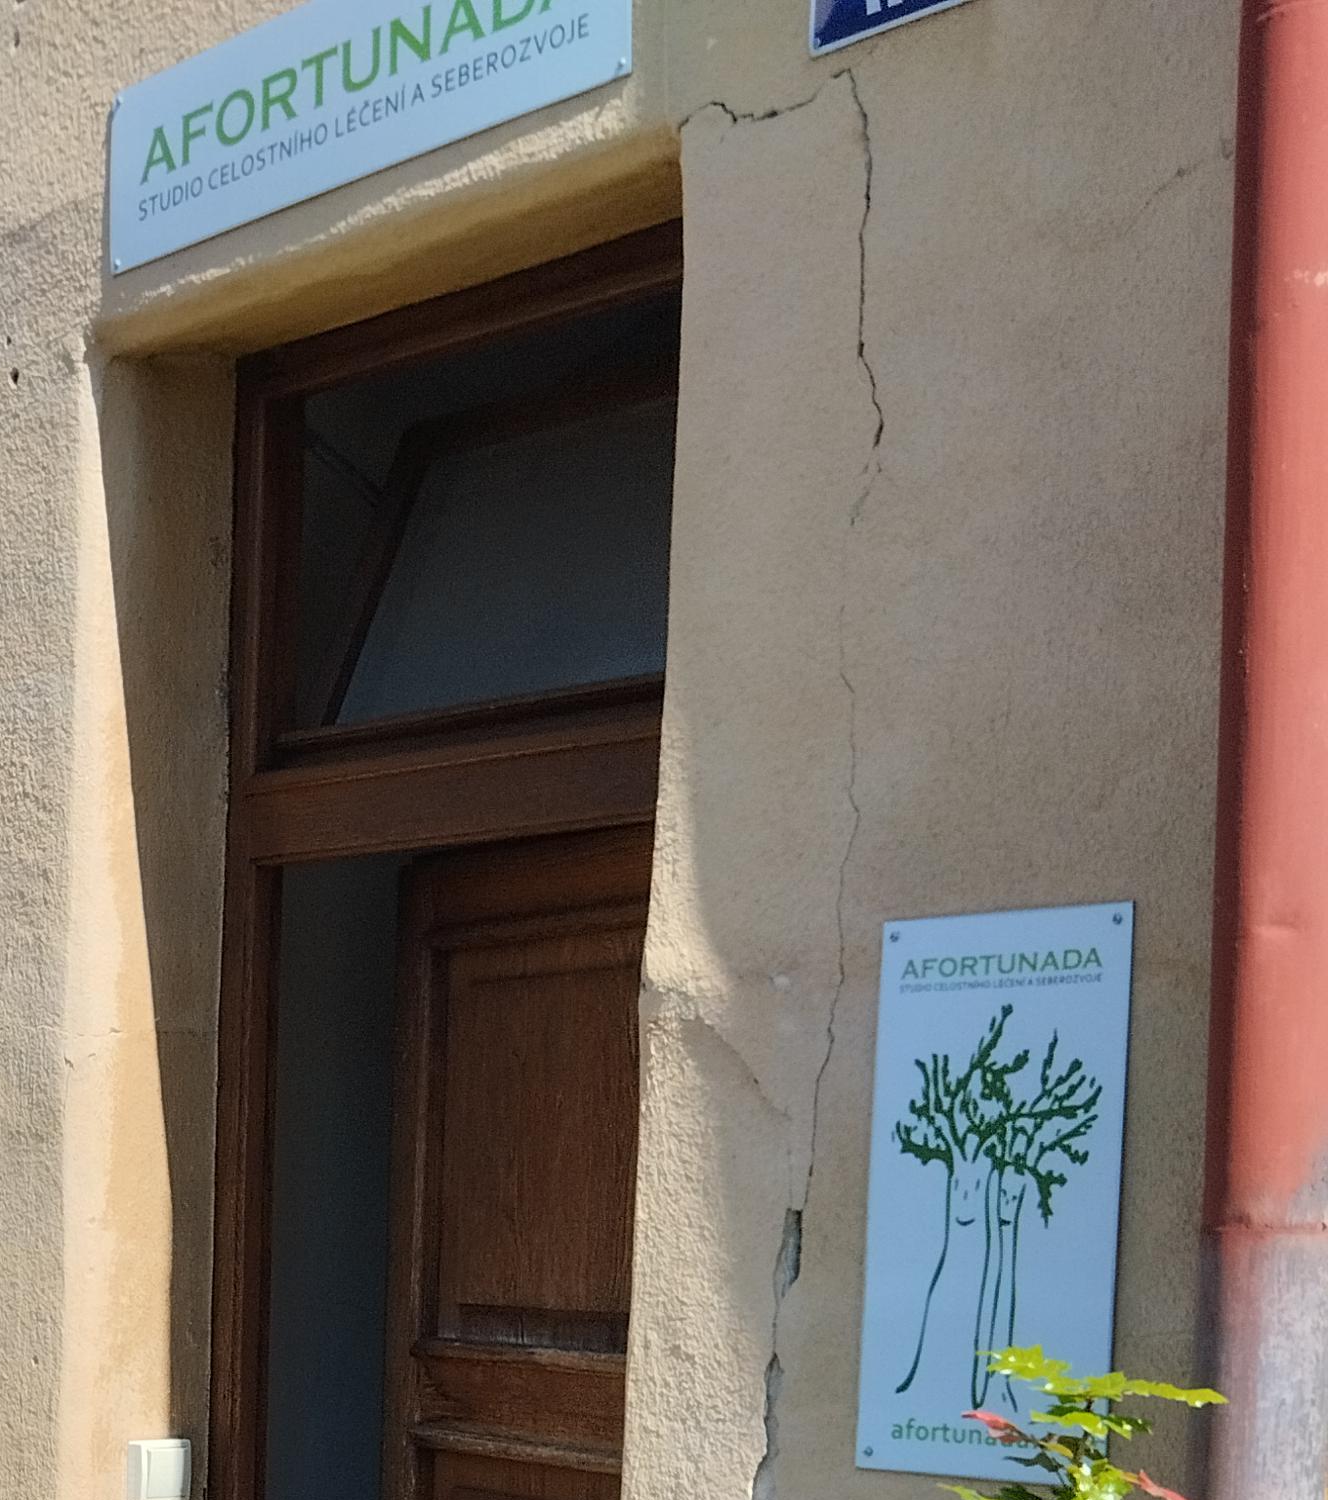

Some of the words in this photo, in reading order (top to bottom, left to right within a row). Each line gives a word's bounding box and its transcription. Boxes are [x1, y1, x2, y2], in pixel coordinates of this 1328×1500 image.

[138, 173, 204, 221] STUDIO
[207, 123, 328, 191] CELOSTNÍHO
[335, 90, 407, 139] LÉČENÍ
[411, 77, 425, 104] A
[431, 14, 590, 98] SEBEROZVOJE
[901, 948, 1103, 980] AFORTUNADA
[1036, 973, 1103, 986] SEBEROZVOJE
